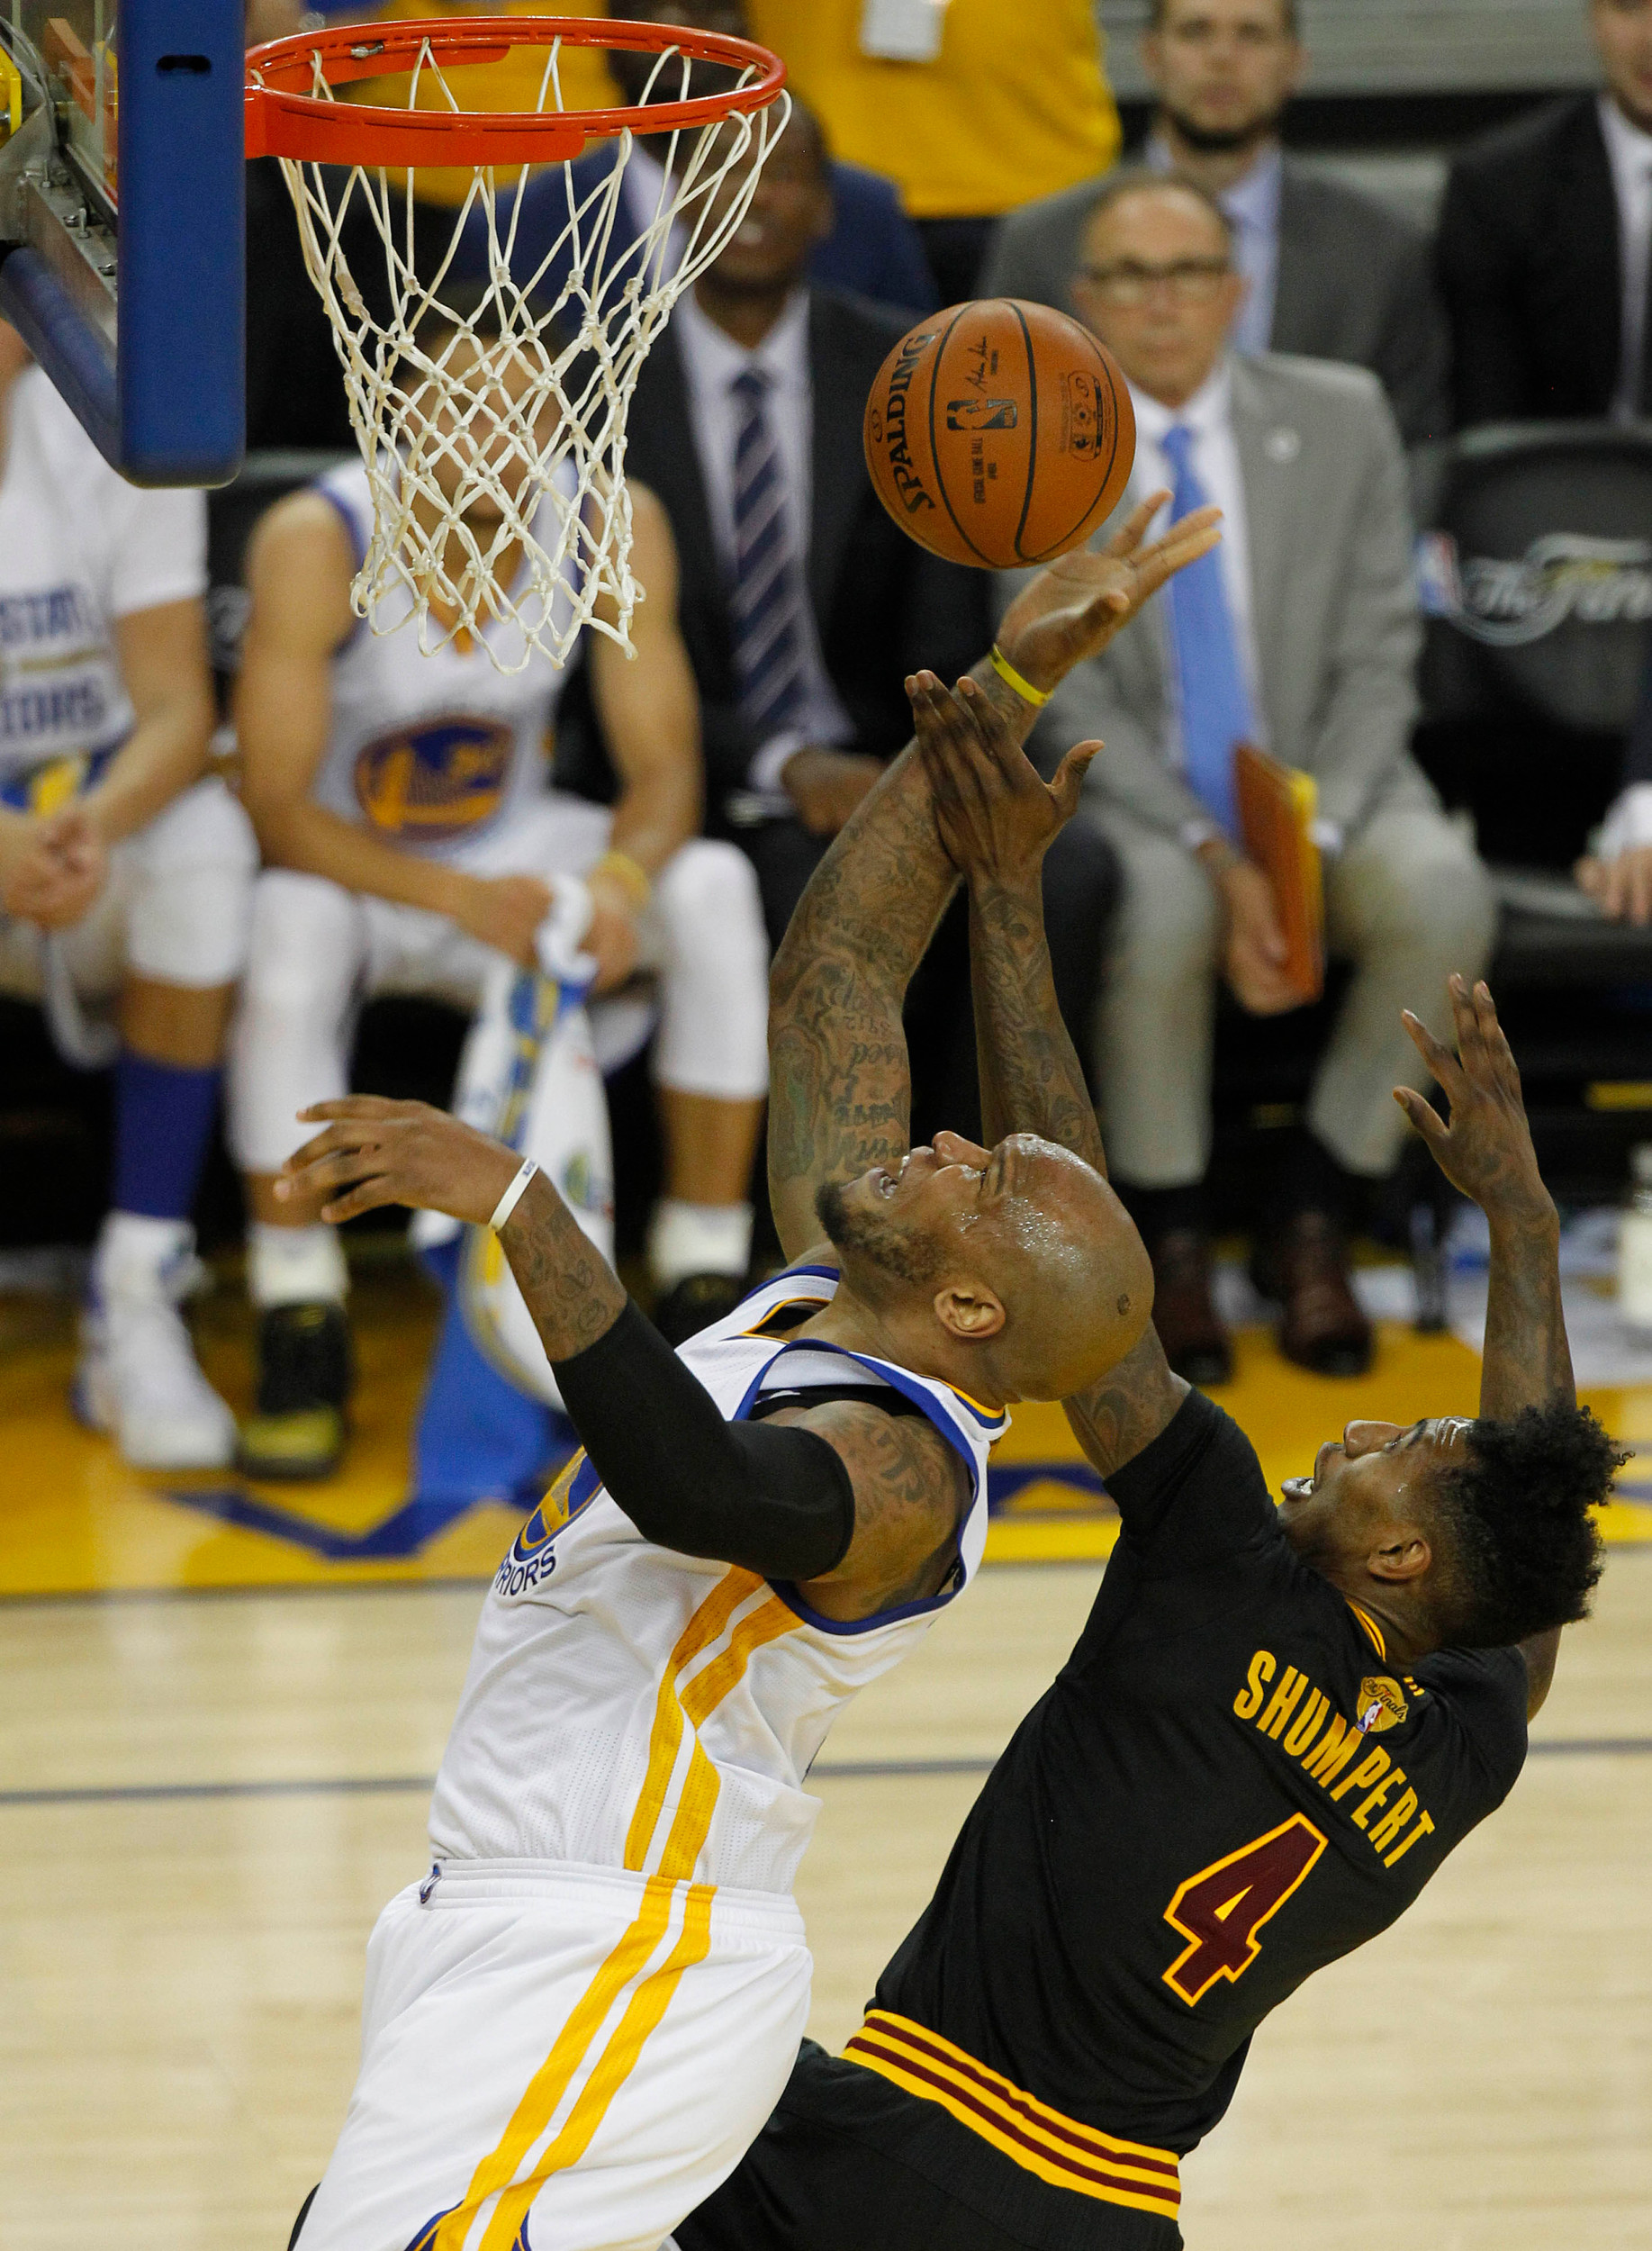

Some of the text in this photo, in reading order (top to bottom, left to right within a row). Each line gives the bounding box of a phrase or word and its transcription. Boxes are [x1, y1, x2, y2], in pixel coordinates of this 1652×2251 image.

[886, 334, 937, 514] SPALDING
[1232, 1650, 1436, 1869] SHUMPERT
[1374, 1683, 1408, 1720] Finals
[1162, 1811, 1330, 2008] 4
